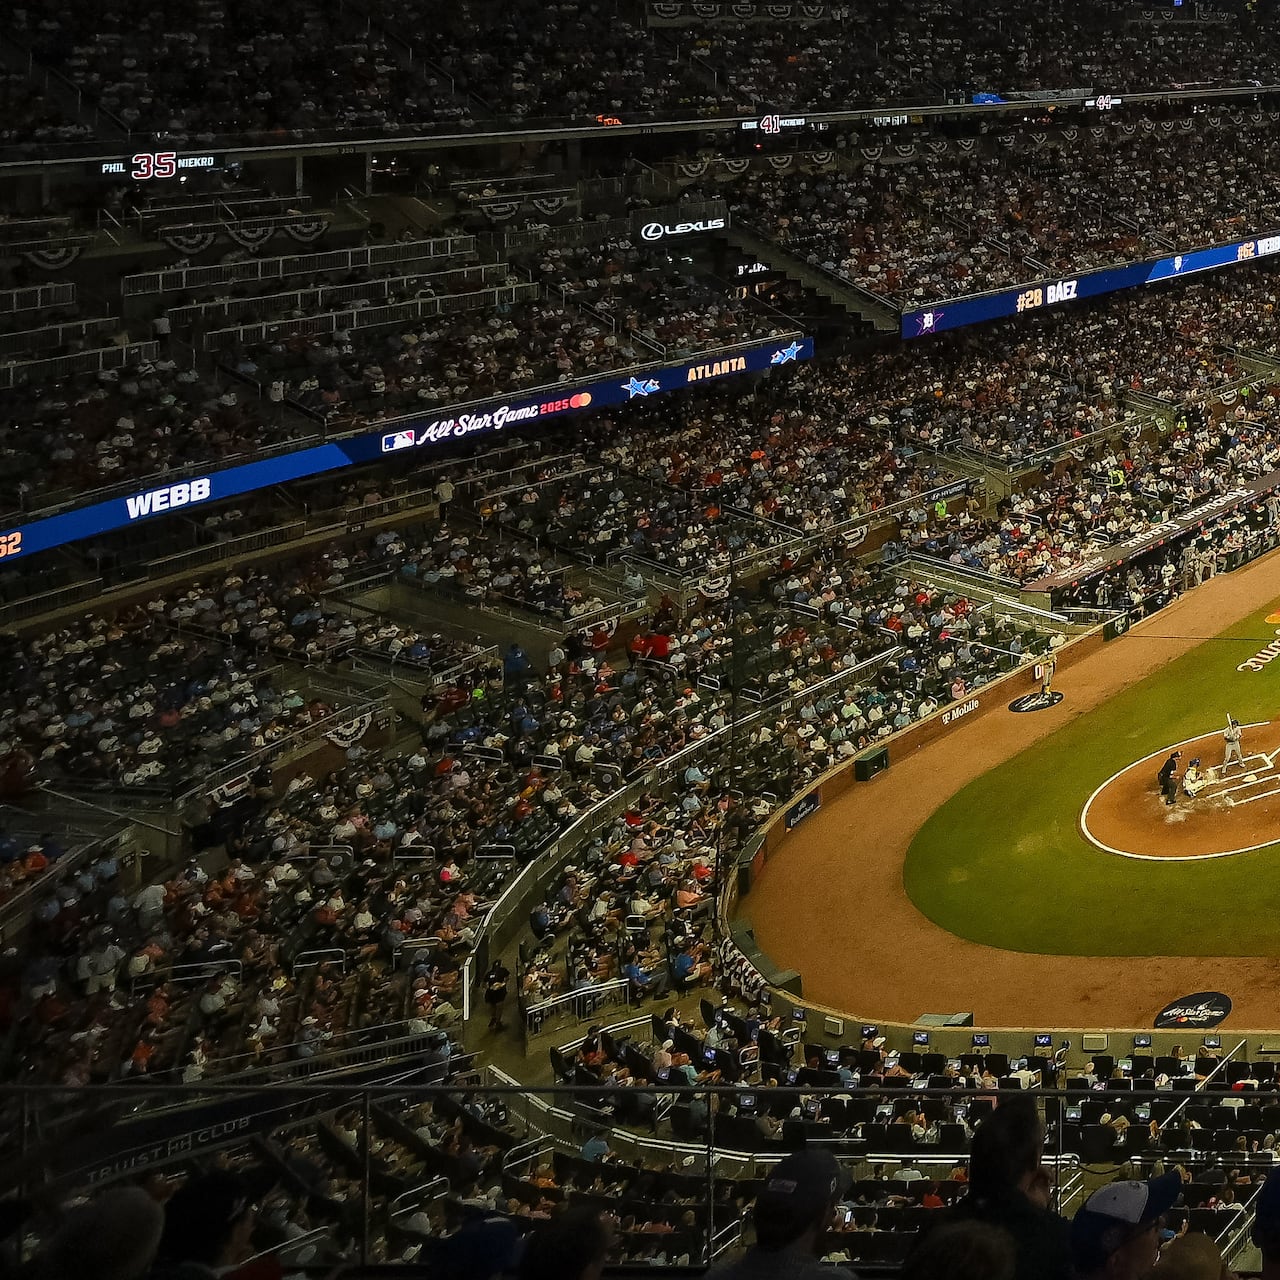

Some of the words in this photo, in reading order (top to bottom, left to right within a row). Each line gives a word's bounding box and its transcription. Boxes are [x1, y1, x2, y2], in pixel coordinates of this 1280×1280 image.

[760, 115, 780, 134] 41
[102, 163, 126, 173] PHIL
[132, 152, 176, 179] 35
[178, 157, 214, 168] NIEKRO
[665, 218, 725, 235] LEXUS
[1016, 290, 1043, 314] #28
[1047, 280, 1077, 305] BÁEZ
[687, 356, 746, 383] ATLANTA
[416, 421, 455, 446] All
[456, 410, 493, 437] Star
[493, 404, 540, 430] Game
[539, 399, 569, 416] 2025
[126, 477, 211, 520] WEBB
[88, 1148, 163, 1183] TRUIST
[198, 1116, 251, 1144] CLUB
